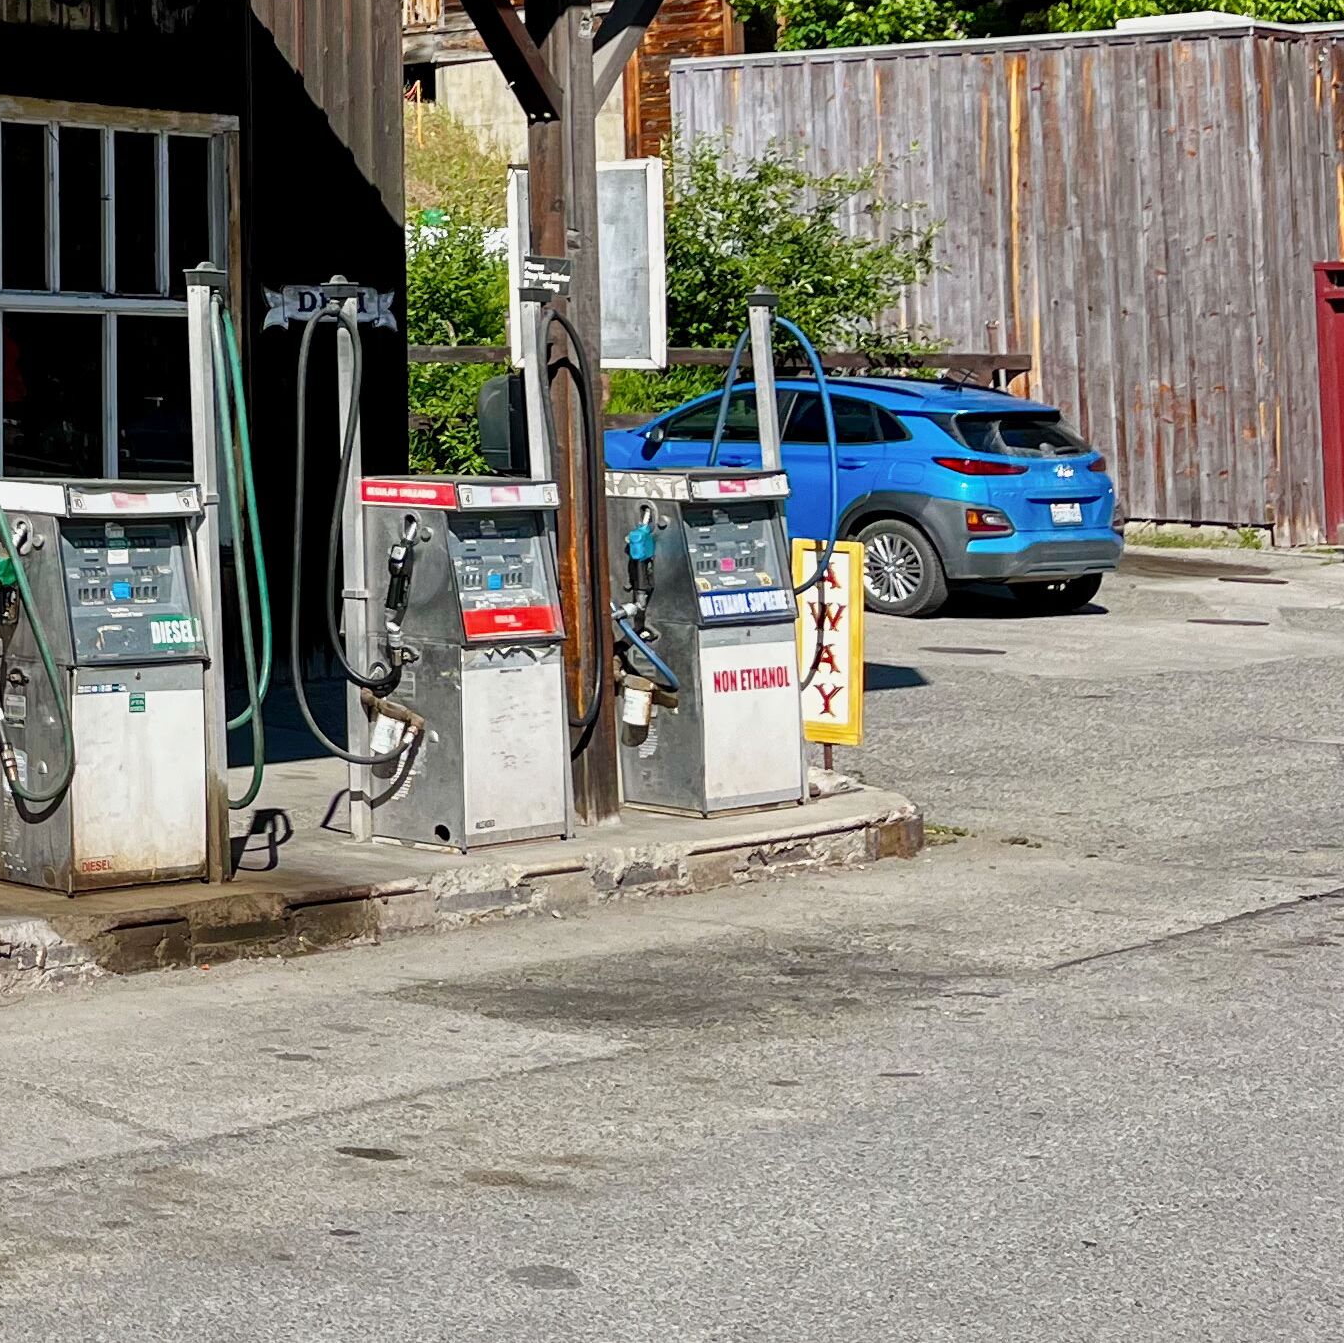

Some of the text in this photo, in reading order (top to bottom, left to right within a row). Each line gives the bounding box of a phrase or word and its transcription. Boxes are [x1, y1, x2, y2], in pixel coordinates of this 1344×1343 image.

[298, 291, 367, 313] DI
[150, 618, 196, 644] DIESEL
[809, 561, 846, 718] AWAY
[713, 666, 790, 693] NON ETHANOL
[81, 857, 113, 872] DIESEL
